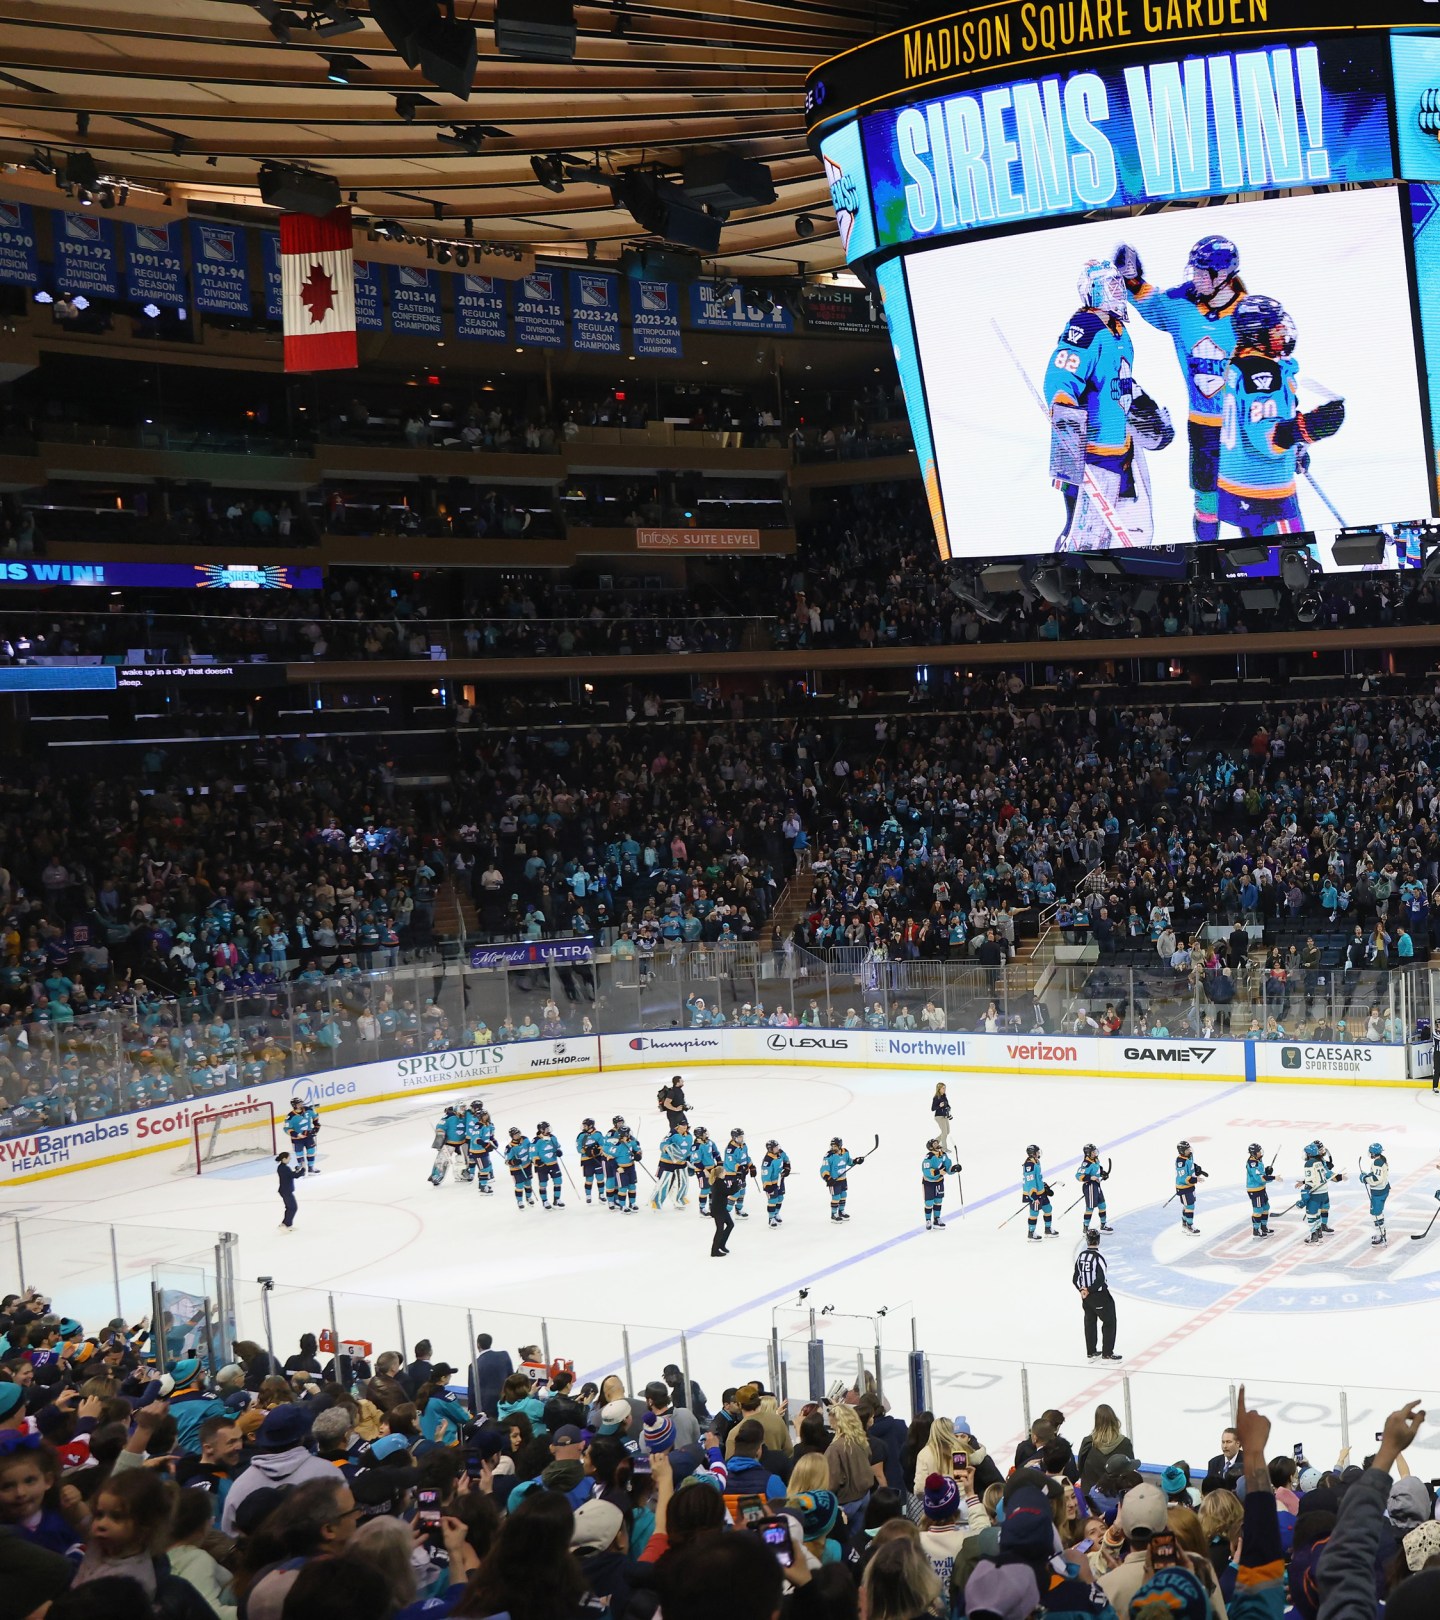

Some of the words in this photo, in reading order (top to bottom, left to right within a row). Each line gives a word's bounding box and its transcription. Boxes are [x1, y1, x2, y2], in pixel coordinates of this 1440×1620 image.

[904, 13, 1012, 80] MADISON
[1021, 0, 1132, 51] SQUARE
[1143, 0, 1269, 33] GARDEN
[897, 73, 1118, 234] SIRENS
[1124, 44, 1330, 197] WIN!
[59, 241, 112, 260] 1991-92
[66, 258, 106, 271] PATRICK
[130, 252, 181, 271] 1991-92
[66, 269, 107, 282] DIVISION
[134, 268, 178, 282] REGULAR
[197, 263, 245, 280] 1993-94
[58, 278, 116, 293] CHAMPIONS
[138, 279, 176, 292] SEASON
[201, 278, 242, 291] ATLANTIC
[130, 288, 184, 303] CHAMPIONS
[204, 289, 241, 301] DIVISION
[394, 290, 437, 304] 2013-14
[197, 297, 249, 312] CHAMPIONS
[353, 298, 377, 308] ANTIC
[398, 303, 435, 313] EASTERN
[458, 296, 503, 309] 2014-15
[517, 303, 561, 315] 2014-15
[355, 307, 375, 316] SION
[392, 311, 442, 324] CONFERENCE
[462, 309, 500, 319] REGULAR
[573, 309, 619, 322] 2023-24
[356, 317, 383, 327] PIONS
[394, 320, 441, 332] CHAMPIONS
[465, 318, 498, 328] SEASON
[514, 316, 565, 327] METROPOLITAN
[635, 314, 677, 326] 2023-24
[458, 326, 506, 338] CHAMPIONS
[526, 325, 555, 334] DIVISION
[578, 322, 615, 333] REGULAR
[633, 327, 681, 336] METROPOLITAN
[520, 333, 561, 343] CHAMPIONS
[581, 331, 613, 341] SEASON
[643, 337, 672, 345] DIVISION
[574, 340, 620, 351] CHAMPIONS
[638, 345, 677, 354] CHAMPIONS
[641, 532, 679, 546] Infosys
[683, 534, 718, 544] SUITE
[720, 534, 756, 544] LEVEL
[31, 564, 104, 583] WIN!
[226, 570, 263, 583] SIRENS
[122, 668, 143, 676] wake
[145, 669, 155, 677] up
[156, 668, 164, 676] in
[172, 668, 187, 677] city
[188, 667, 204, 675] that
[205, 667, 233, 675] doesn't
[119, 678, 143, 687] sleep.
[540, 944, 593, 958] ULTRA
[629, 1036, 719, 1053] Champion
[789, 1038, 849, 1050] LEXUS
[889, 1039, 966, 1057] Northwell
[1006, 1041, 1077, 1062] verizon
[1304, 1047, 1372, 1062] CAESARS
[397, 1046, 504, 1077] SPROUTS
[1305, 1060, 1361, 1072] SPORTSBOOK
[403, 1070, 452, 1087] FARMERS
[453, 1065, 500, 1080] MARKET
[12, 1149, 70, 1172] HEALTH
[1079, 1260, 1091, 1272] 72
[1278, 1291, 1394, 1307] YORK
[934, 1556, 954, 1568] will
